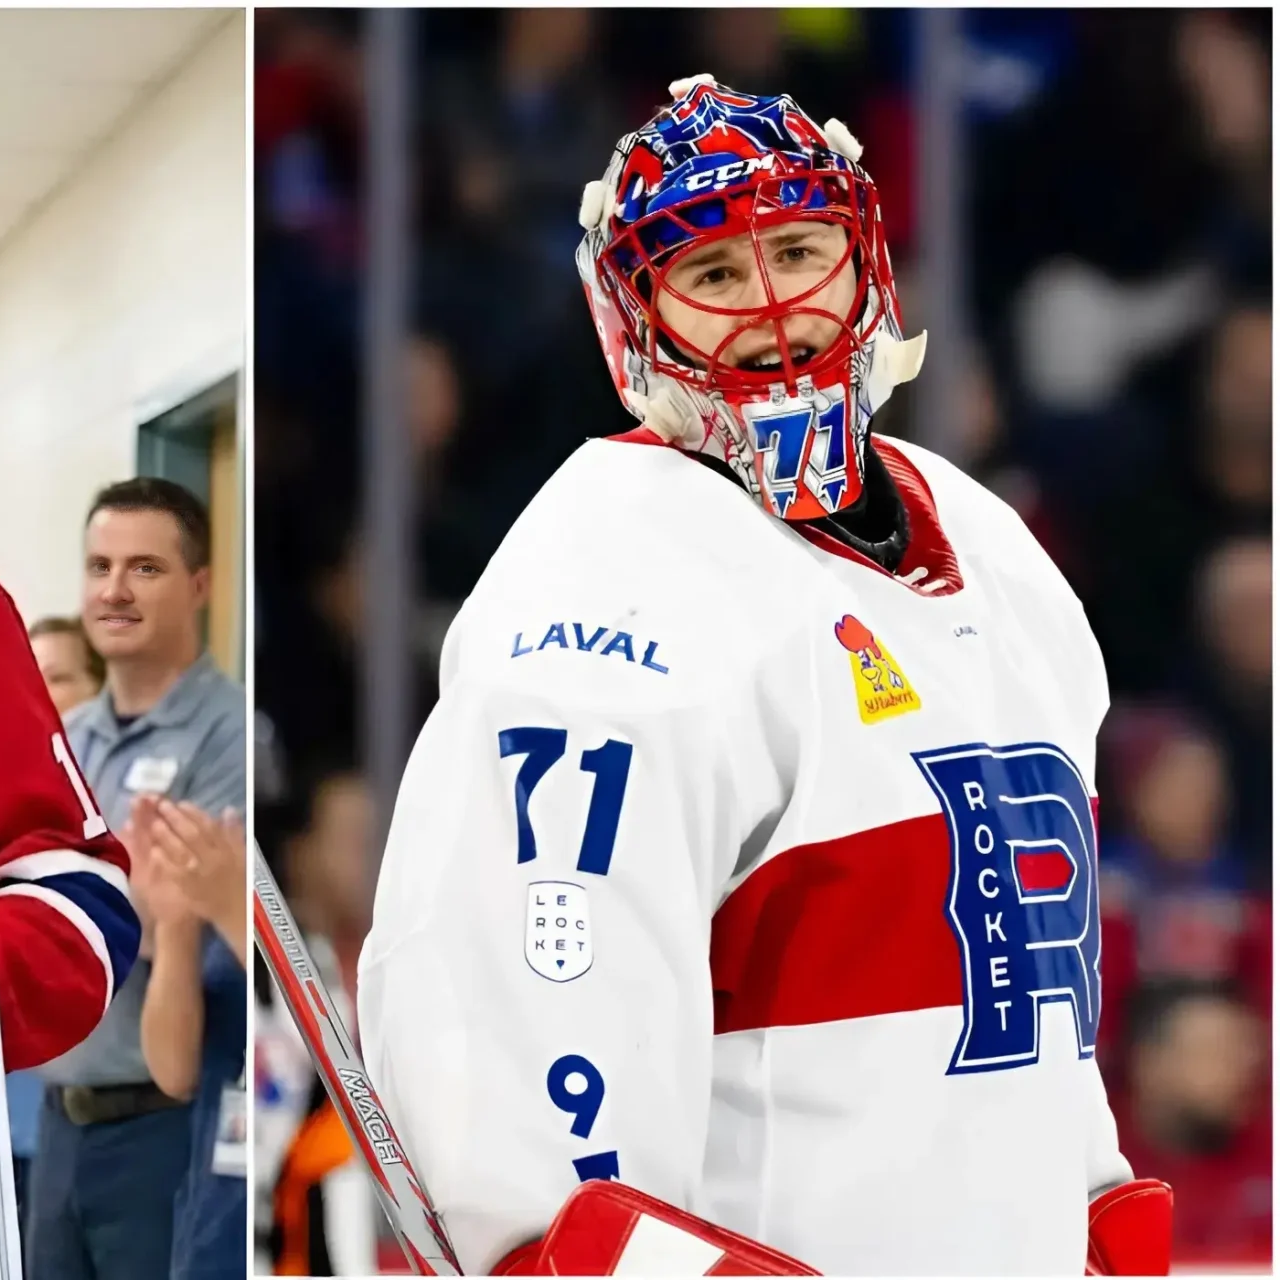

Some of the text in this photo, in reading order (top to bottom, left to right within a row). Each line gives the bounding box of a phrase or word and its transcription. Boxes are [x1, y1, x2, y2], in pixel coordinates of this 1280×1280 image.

[685, 152, 776, 191] CCM
[750, 400, 848, 518] 71
[510, 622, 670, 676] LAVAL
[51, 732, 108, 840] 1
[497, 726, 634, 877] 71
[535, 894, 568, 907] LE
[963, 781, 1013, 1032] ROCKET
[339, 1068, 404, 1166] MACH
